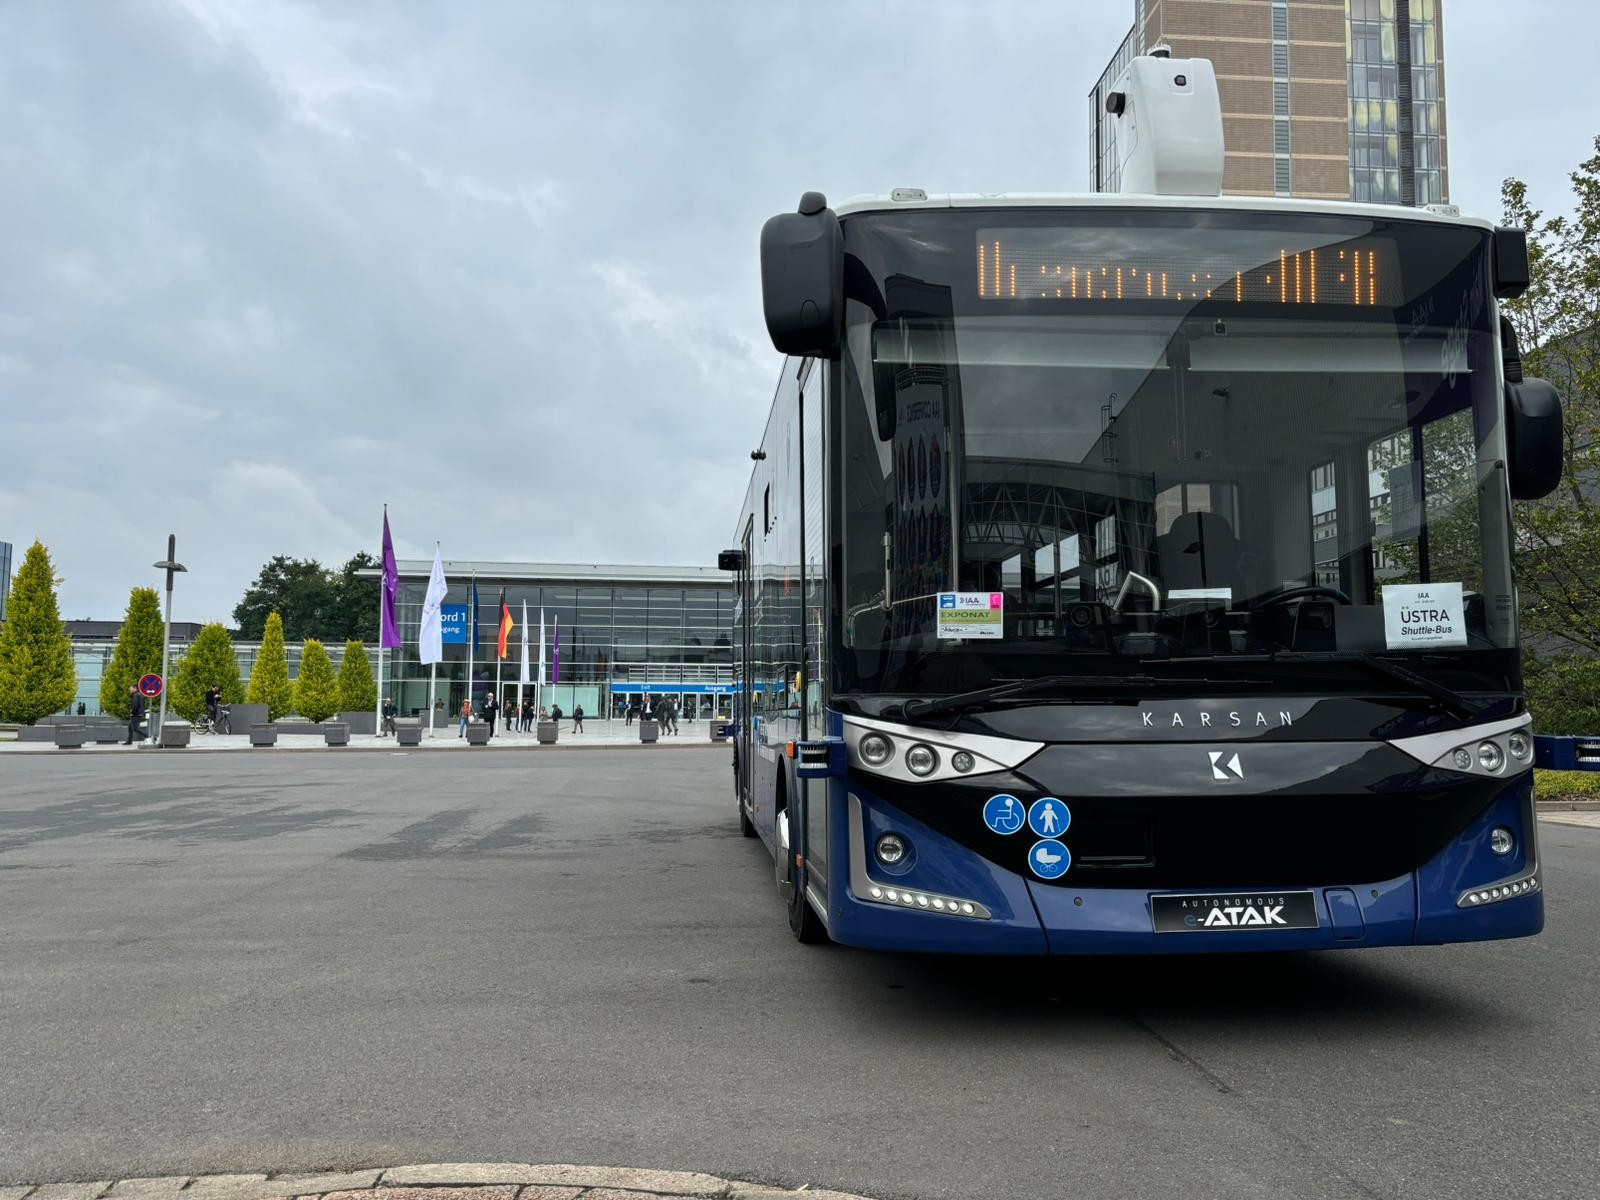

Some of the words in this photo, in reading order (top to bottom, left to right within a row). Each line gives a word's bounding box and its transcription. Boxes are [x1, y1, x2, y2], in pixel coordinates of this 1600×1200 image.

[440, 611, 458, 622] ord
[461, 612, 466, 622] 1
[1401, 606, 1450, 623] ÜSTRA
[1401, 625, 1453, 636] Shuttle-Bus
[1142, 711, 1292, 727] KARSAN
[1182, 897, 1285, 908] AUTONOMOUS
